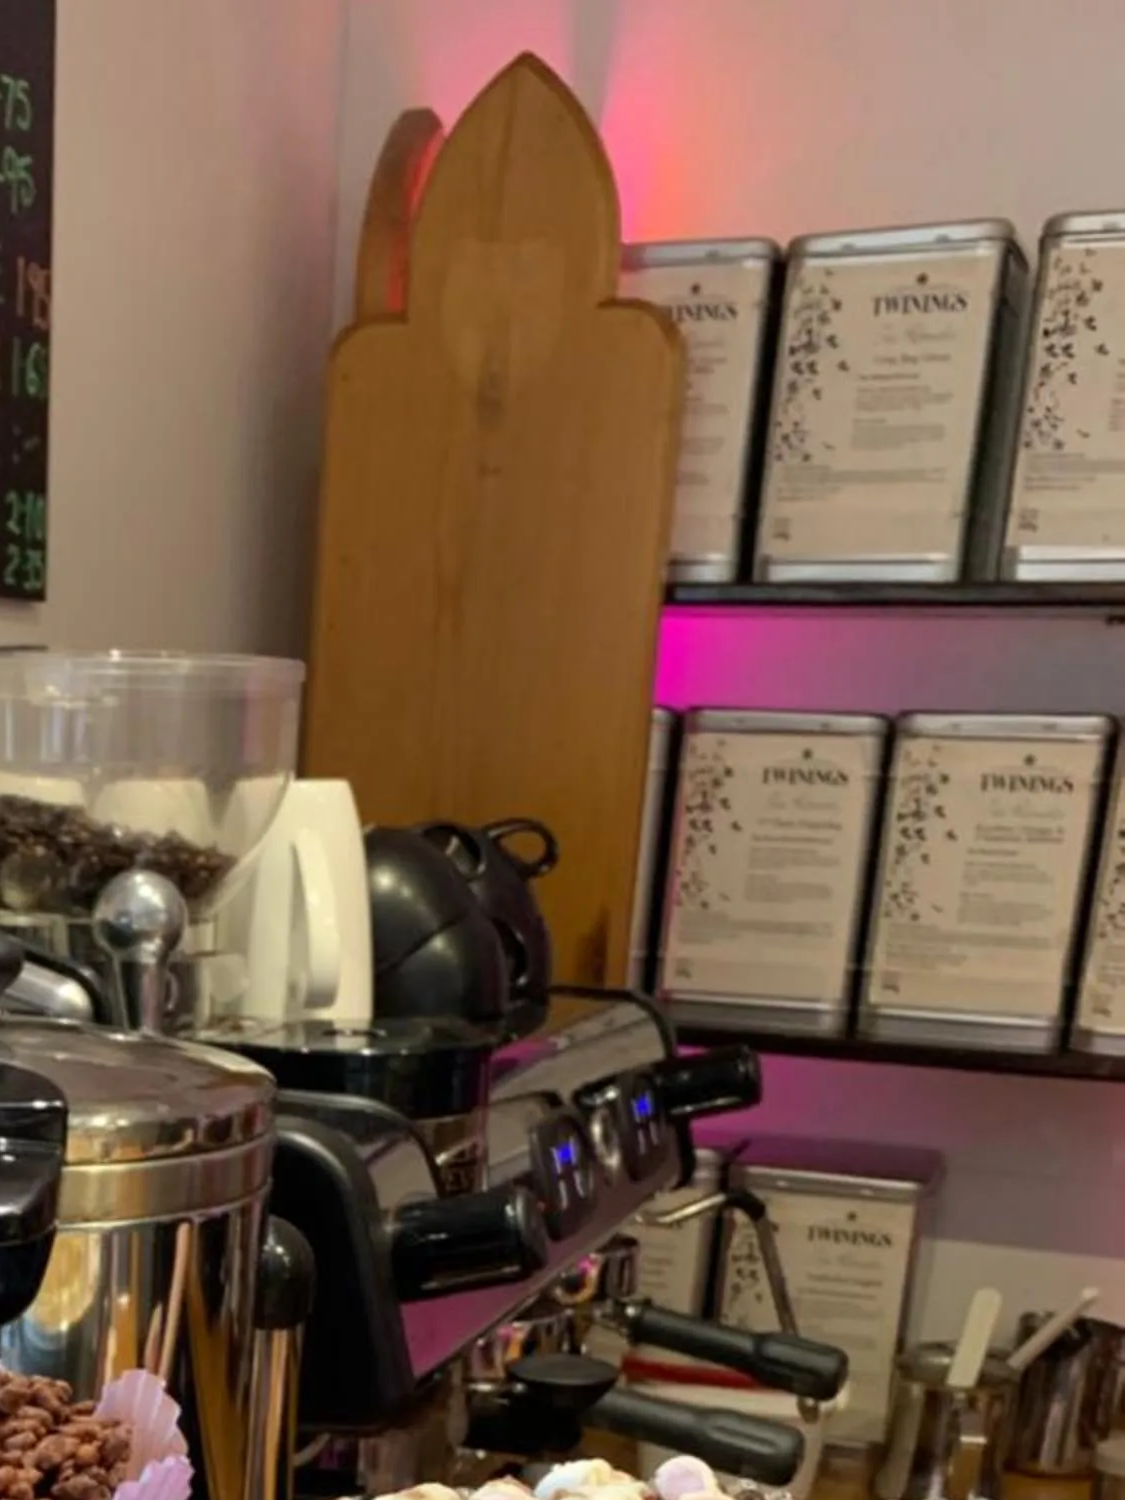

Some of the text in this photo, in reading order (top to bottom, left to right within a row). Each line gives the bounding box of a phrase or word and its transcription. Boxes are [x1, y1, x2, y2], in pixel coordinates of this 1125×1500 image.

[873, 292, 969, 317] TWININGS
[761, 766, 850, 787] TWININGS
[980, 772, 1074, 795] TWININGS
[807, 1225, 894, 1248] TWININGS
